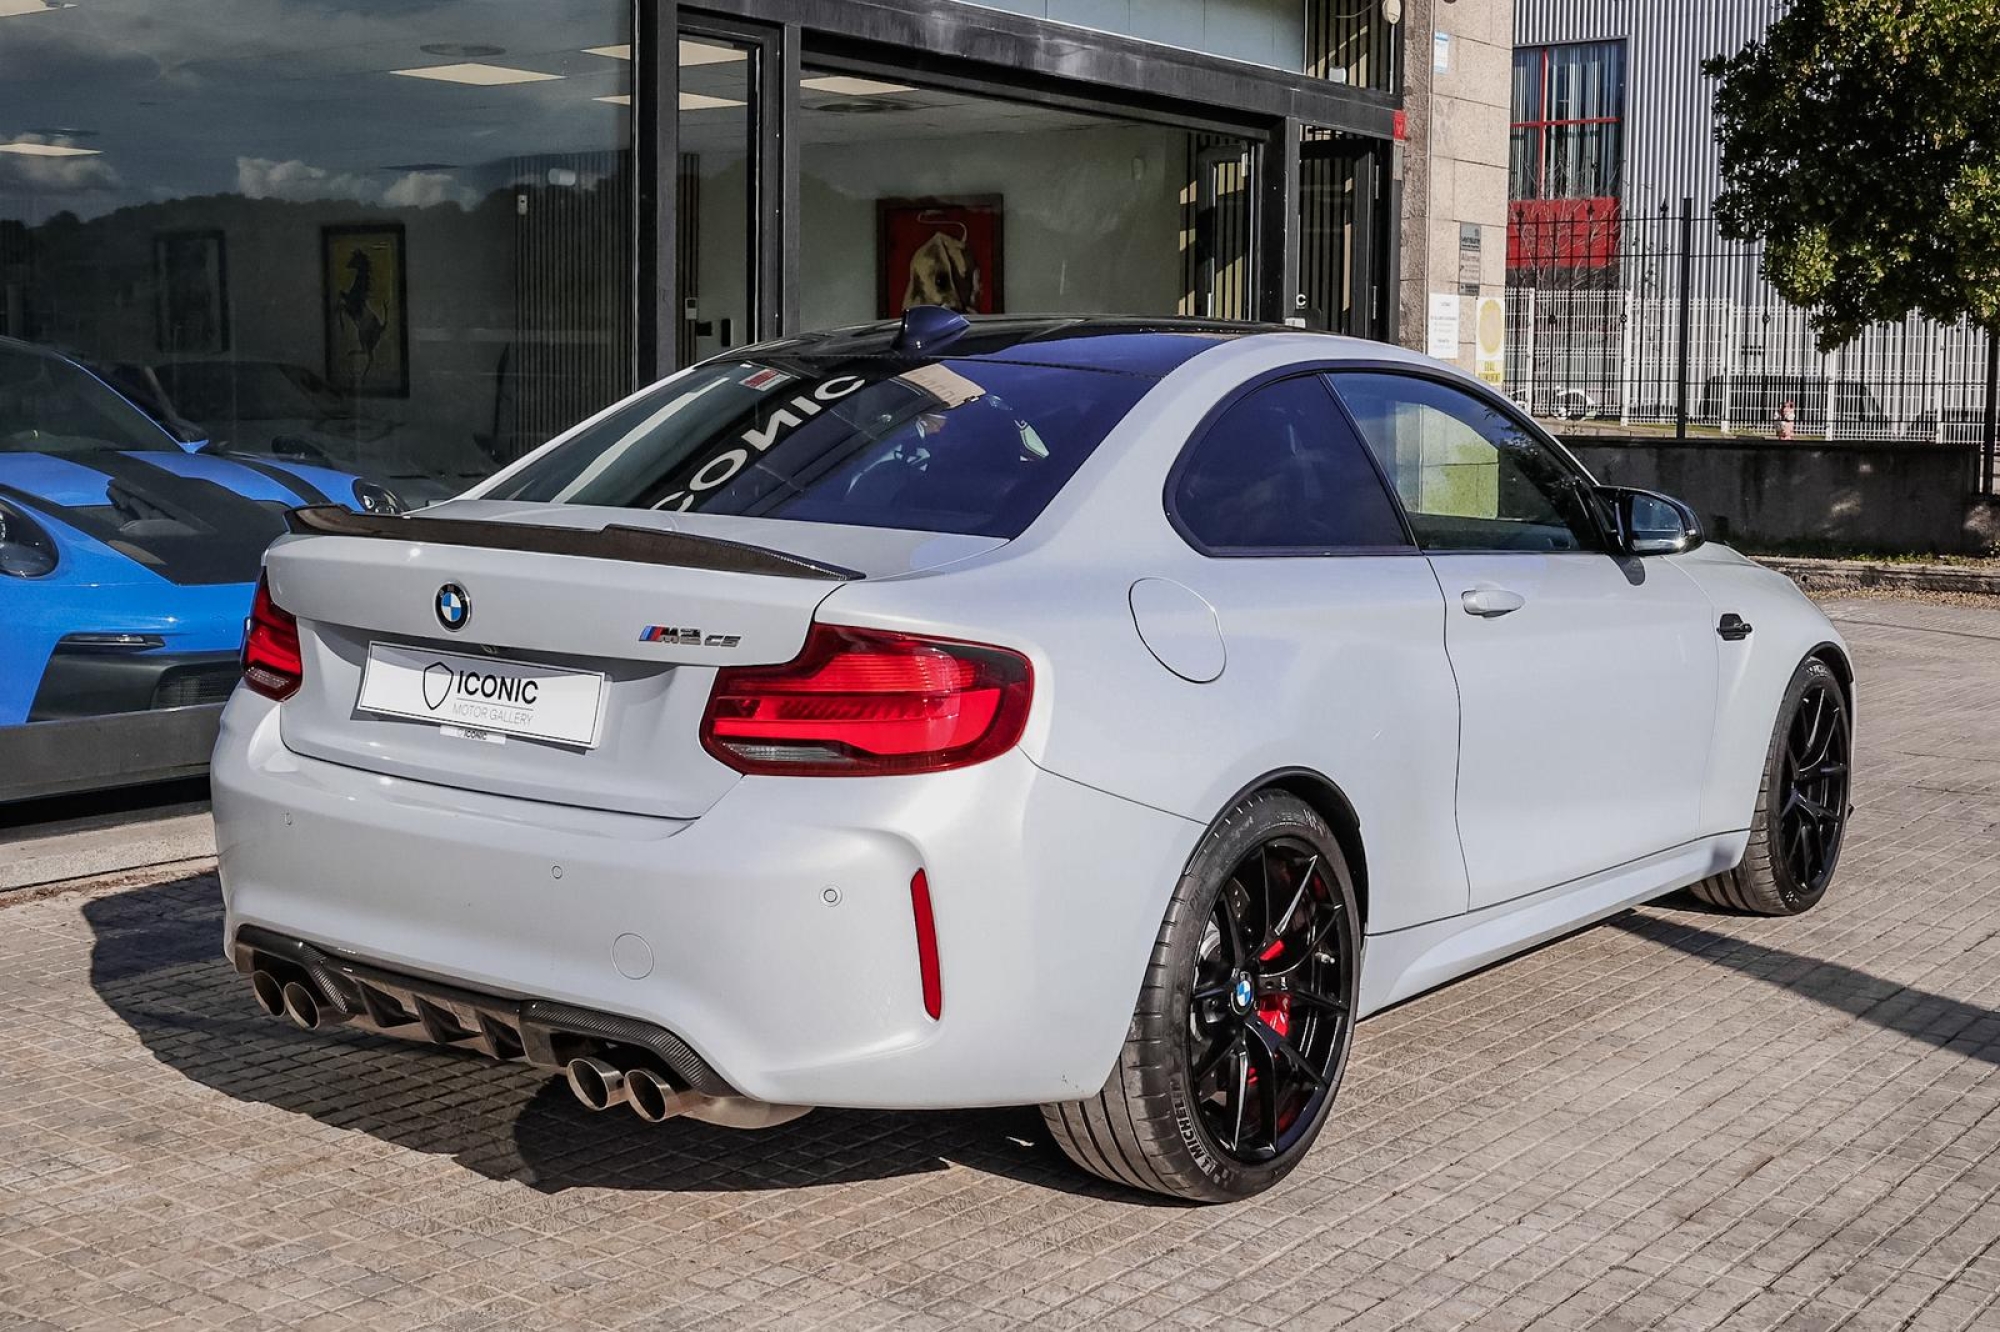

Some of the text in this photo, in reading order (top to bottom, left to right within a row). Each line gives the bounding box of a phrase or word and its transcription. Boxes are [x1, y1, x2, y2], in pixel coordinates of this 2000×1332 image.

[457, 670, 538, 704] ICONIC
[453, 702, 535, 727] MOTOR GALLERY
